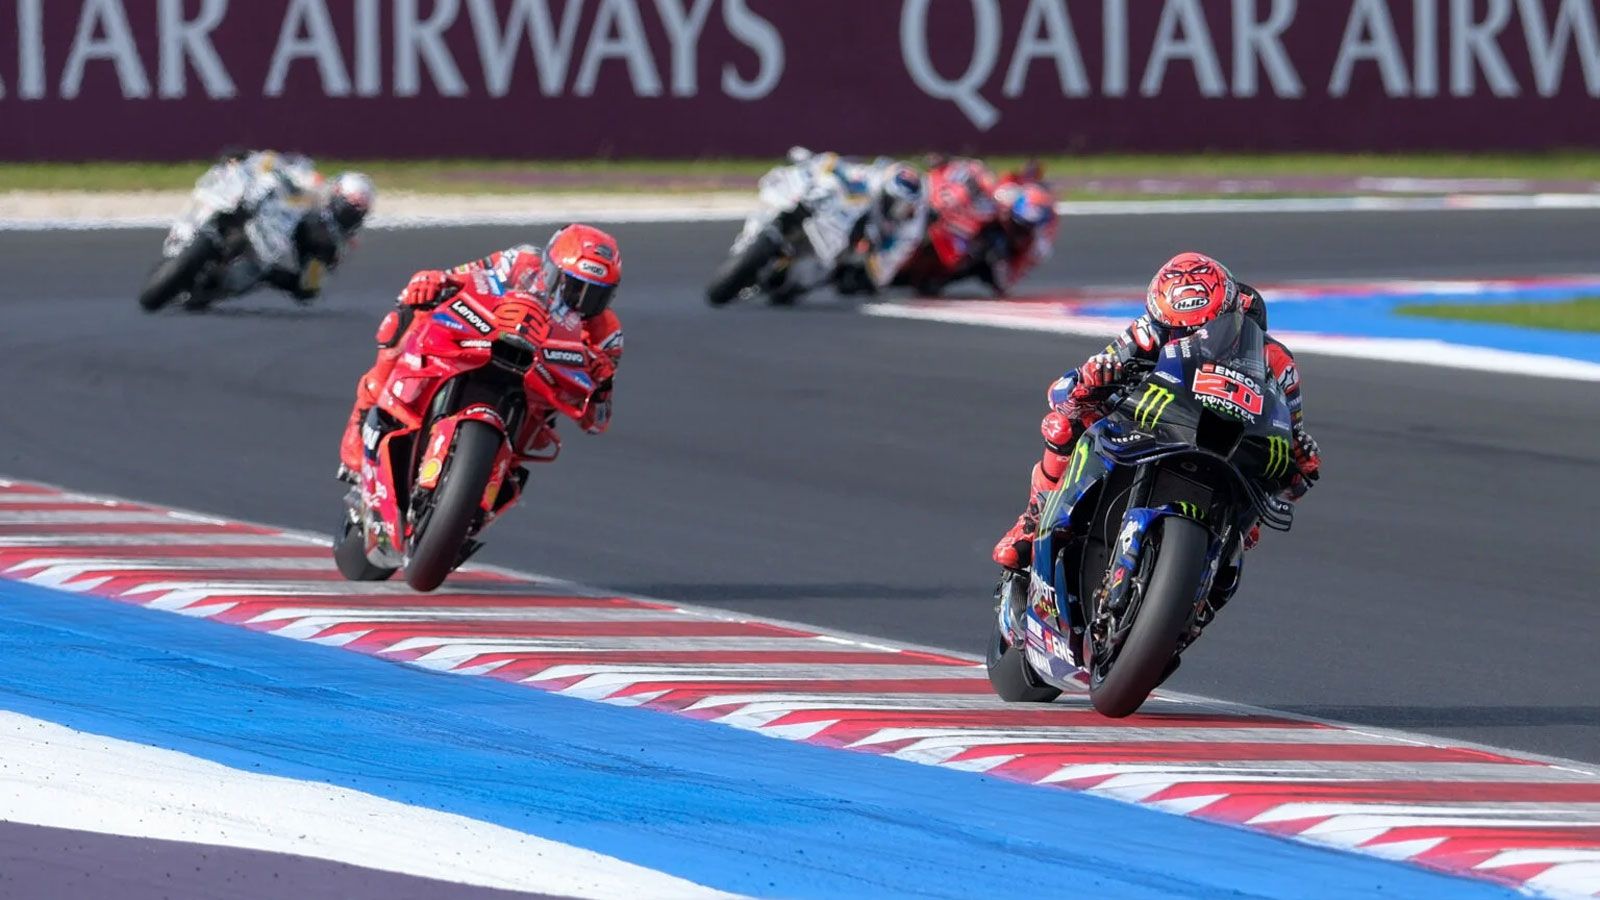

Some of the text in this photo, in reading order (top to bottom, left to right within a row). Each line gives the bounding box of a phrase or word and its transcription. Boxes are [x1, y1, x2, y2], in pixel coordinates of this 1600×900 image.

[0, 0, 785, 99] TAR AIRWAYS
[900, 0, 1302, 129] QATAR
[451, 300, 491, 333] Lenovo
[1177, 299, 1206, 311] HJC
[543, 349, 583, 362] Lenovo
[1214, 365, 1261, 395] ENEOS
